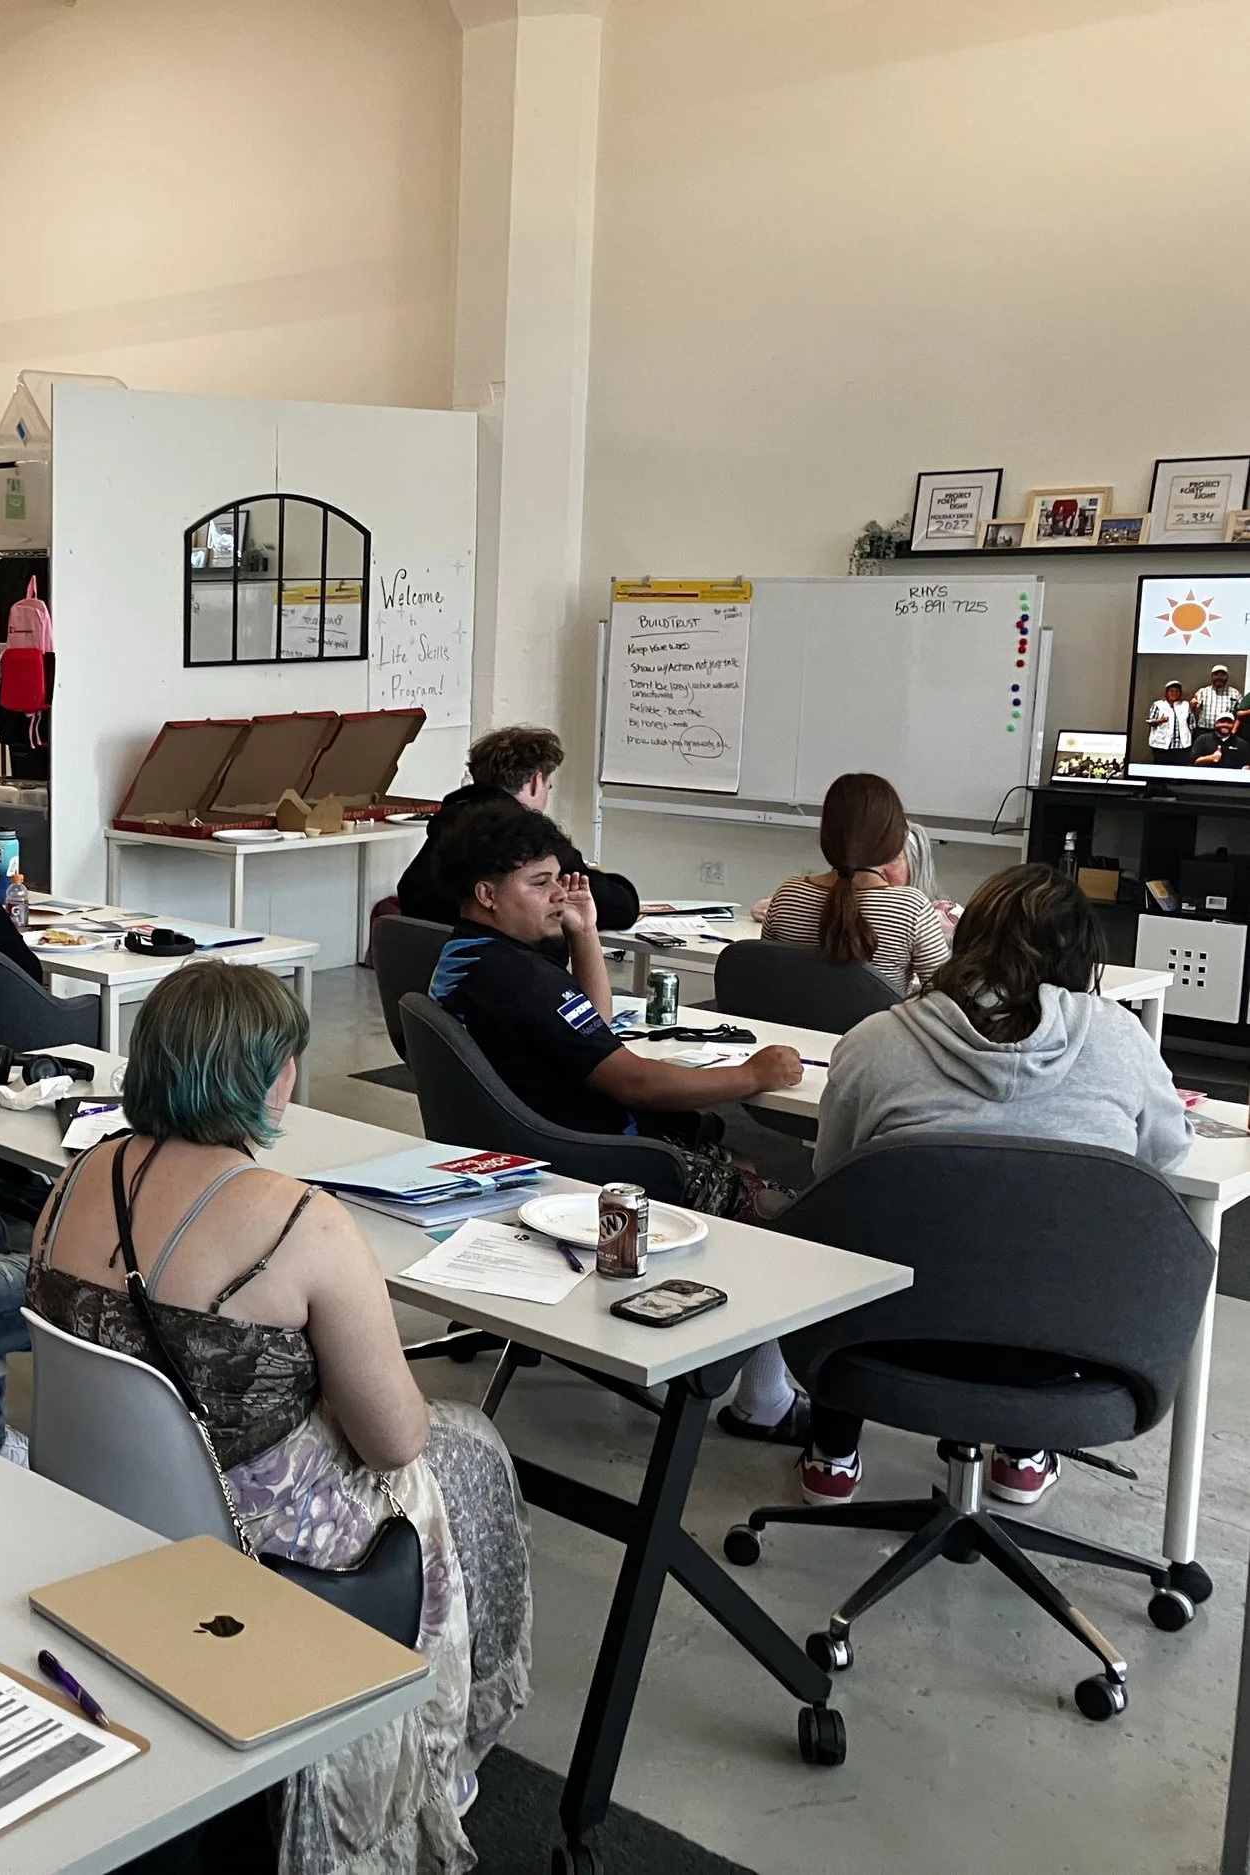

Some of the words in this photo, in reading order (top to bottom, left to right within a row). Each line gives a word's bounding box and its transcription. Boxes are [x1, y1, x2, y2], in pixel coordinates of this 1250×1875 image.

[380, 569, 444, 609] Welcome
[909, 585, 948, 598] RHYS
[378, 636, 408, 666] Life
[417, 633, 450, 662] Skills
[391, 674, 444, 702] Program!
